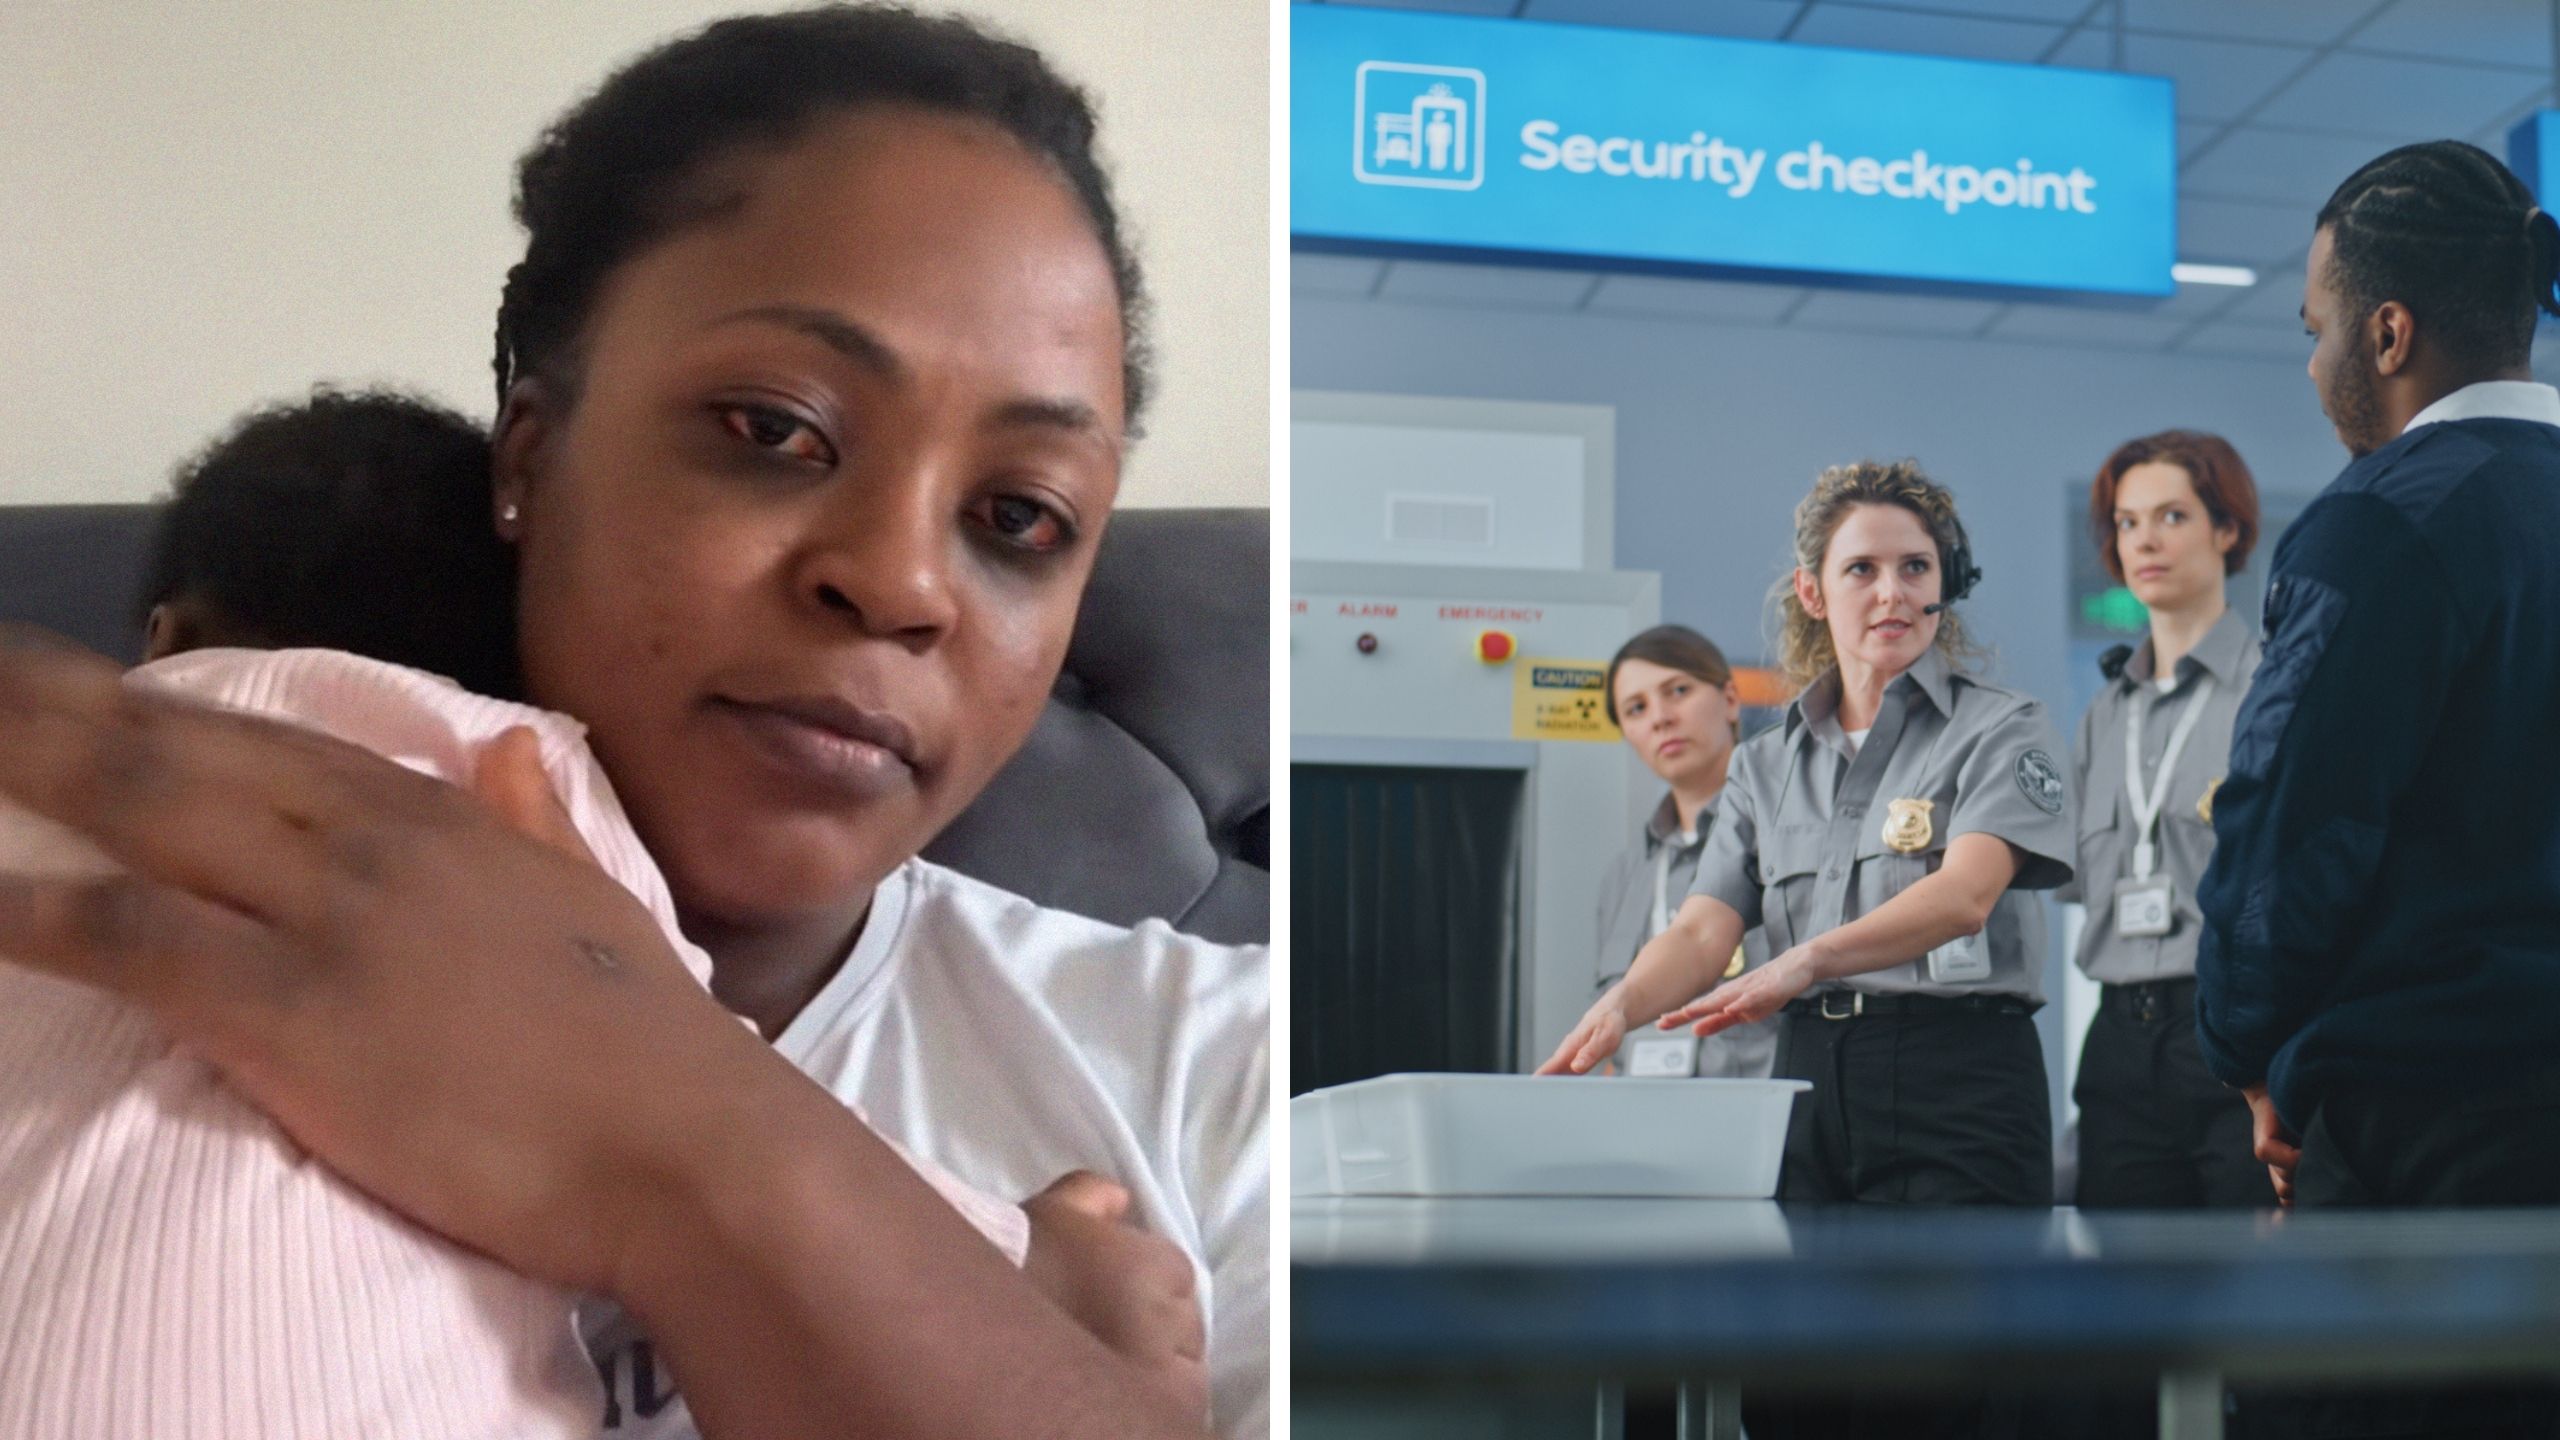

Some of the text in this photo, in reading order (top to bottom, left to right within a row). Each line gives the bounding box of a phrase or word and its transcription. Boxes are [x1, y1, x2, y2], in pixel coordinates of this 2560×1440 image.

[1519, 119, 2097, 214] Security checkpoint
[1338, 603, 1398, 618] ALARM
[1439, 605, 1544, 622] EMERGENCY
[1535, 670, 1602, 686] CAUTION
